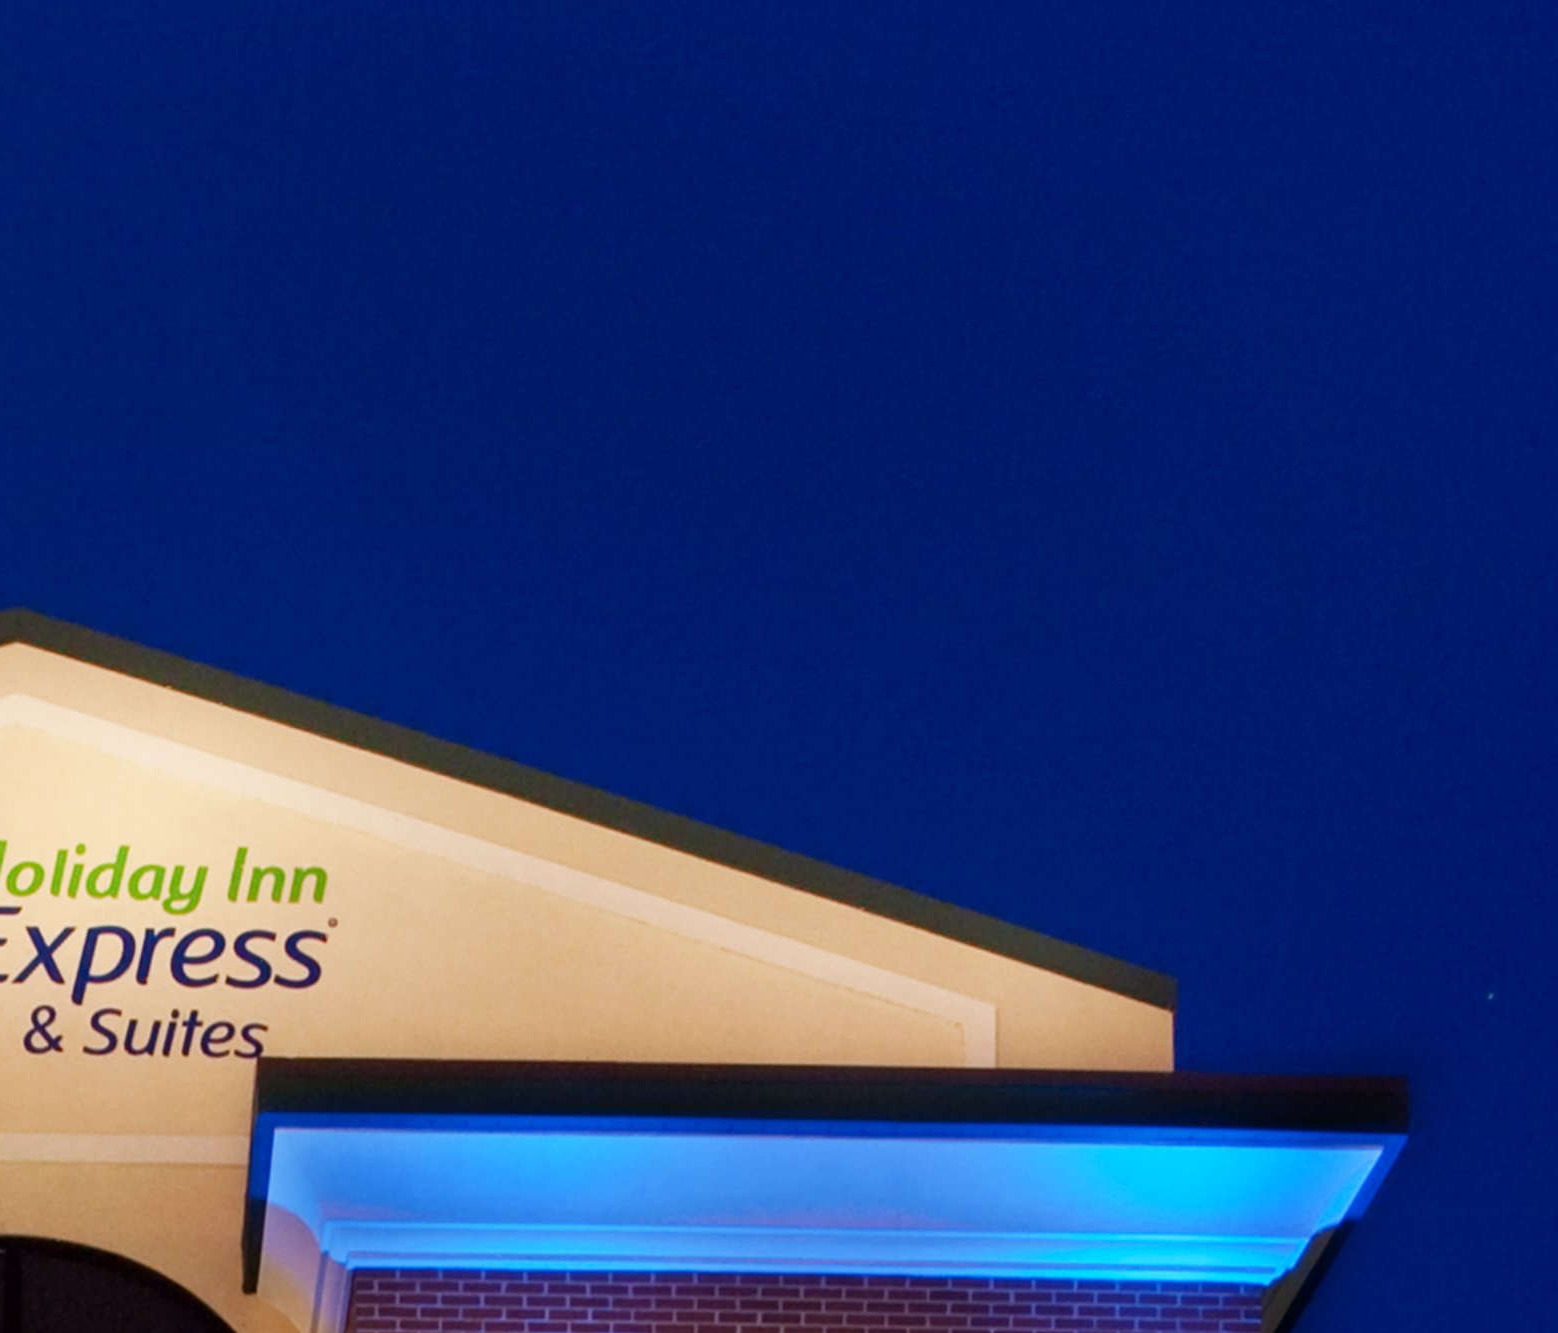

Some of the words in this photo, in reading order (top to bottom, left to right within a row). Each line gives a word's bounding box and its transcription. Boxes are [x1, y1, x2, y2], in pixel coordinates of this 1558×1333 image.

[225, 847, 328, 904] Inn
[23, 1005, 64, 1055] &
[82, 1007, 269, 1059] Suites
